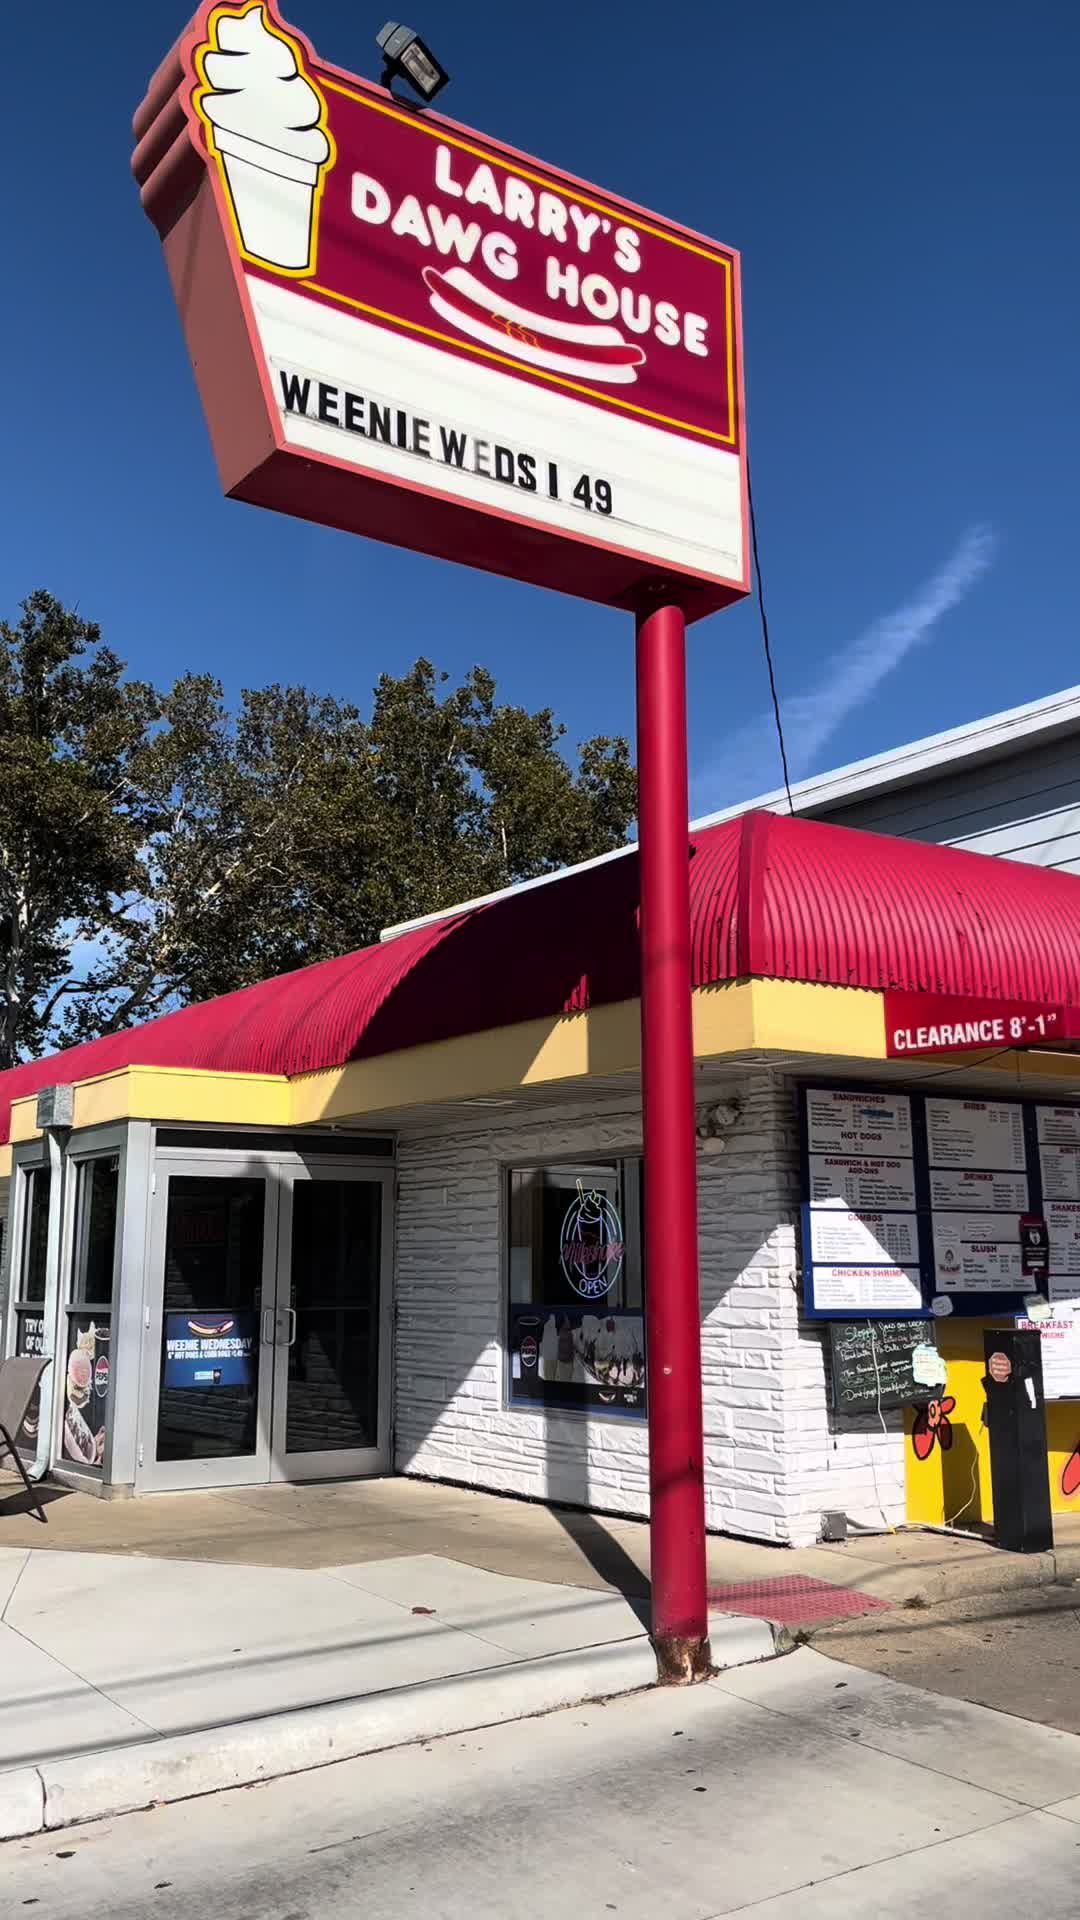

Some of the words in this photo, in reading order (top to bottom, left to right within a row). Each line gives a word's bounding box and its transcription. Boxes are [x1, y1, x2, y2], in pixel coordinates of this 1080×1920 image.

[435, 145, 641, 273] LARRY'S
[351, 171, 519, 280] DAWG
[546, 255, 709, 357] HOUSE
[280, 370, 432, 457] WEENIE
[440, 425, 538, 493] WEDS
[573, 473, 613, 515] 49
[893, 1017, 1005, 1050] CLEARANCE
[841, 1131, 857, 1140] HOT
[860, 1132, 882, 1140] DOGS
[824, 1158, 861, 1167] SANDWICH
[847, 1213, 883, 1222] COMBOS
[971, 1245, 997, 1253] SLUSH
[579, 1274, 608, 1294] OPEN
[167, 1339, 200, 1351] WEENIE
[200, 1338, 252, 1350] WEDNESDAY
